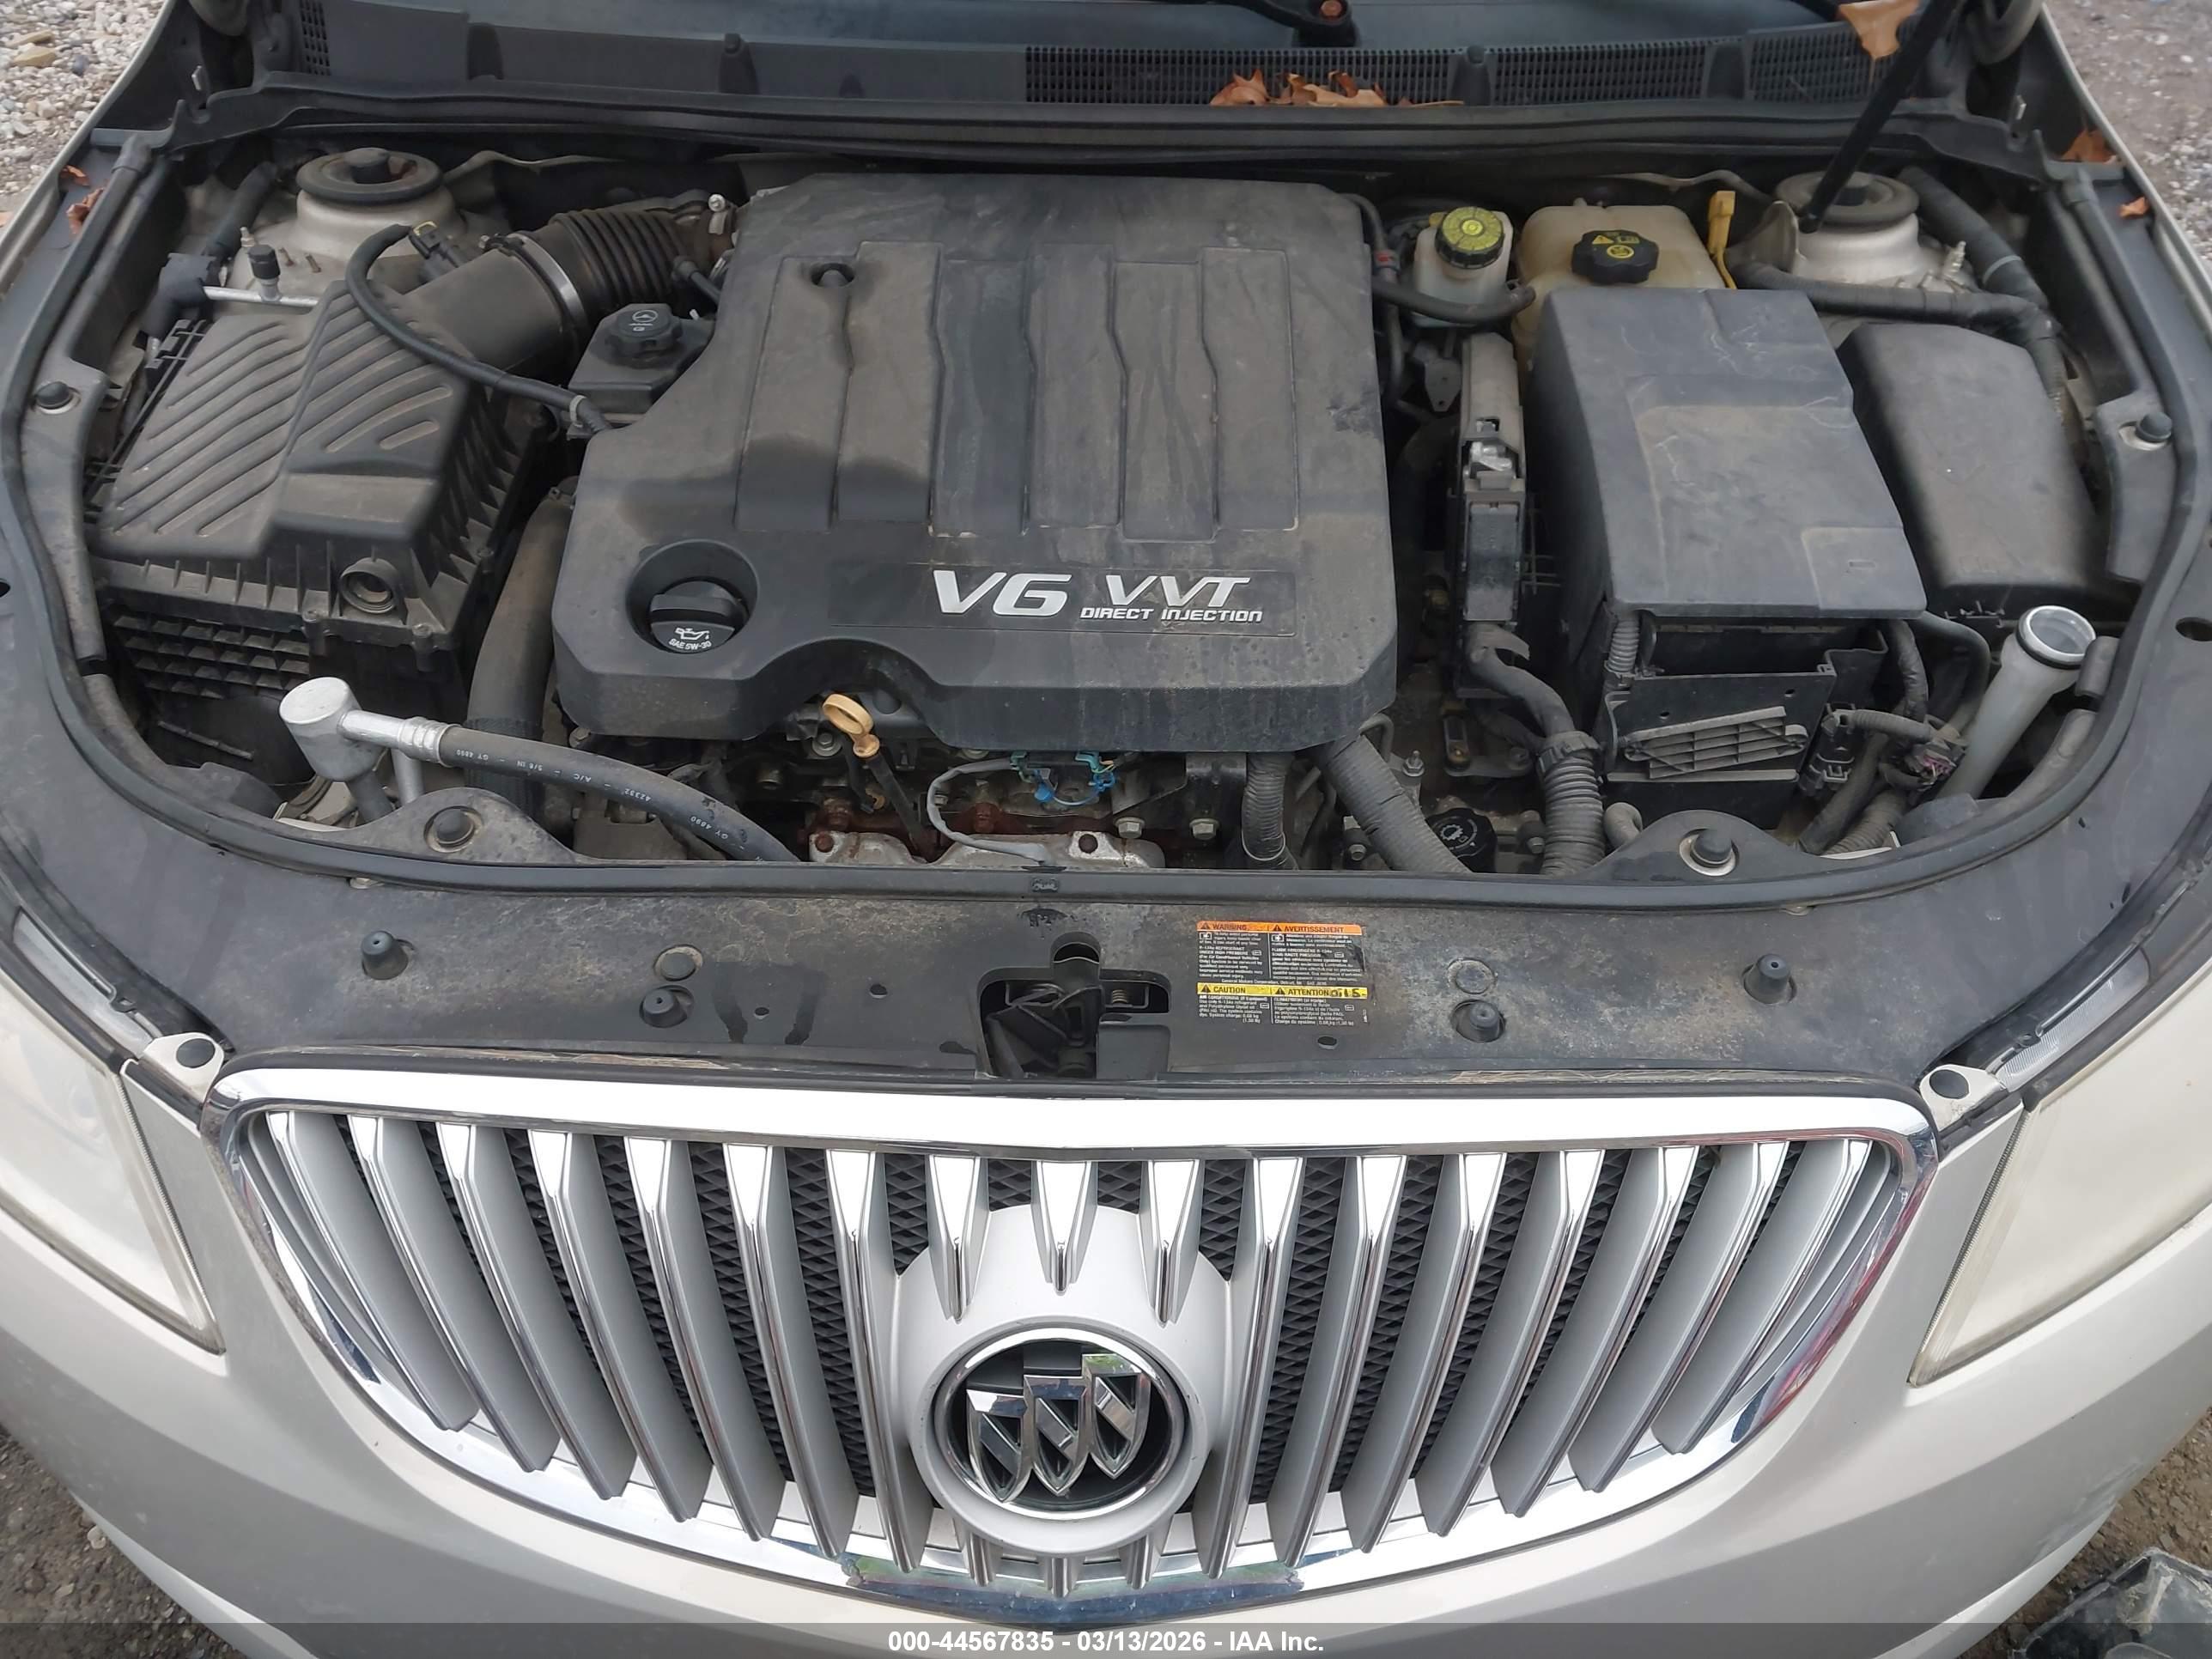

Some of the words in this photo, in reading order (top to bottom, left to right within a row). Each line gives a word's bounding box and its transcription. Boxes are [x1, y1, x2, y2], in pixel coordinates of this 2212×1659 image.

[933, 570, 1073, 617] V6
[1105, 574, 1251, 607] VVT
[1080, 607, 1154, 620] DIRECT
[1161, 609, 1262, 623] INJECTION
[669, 638, 685, 649] SAE
[685, 640, 712, 650] 5W-30
[574, 773, 591, 782] A/C
